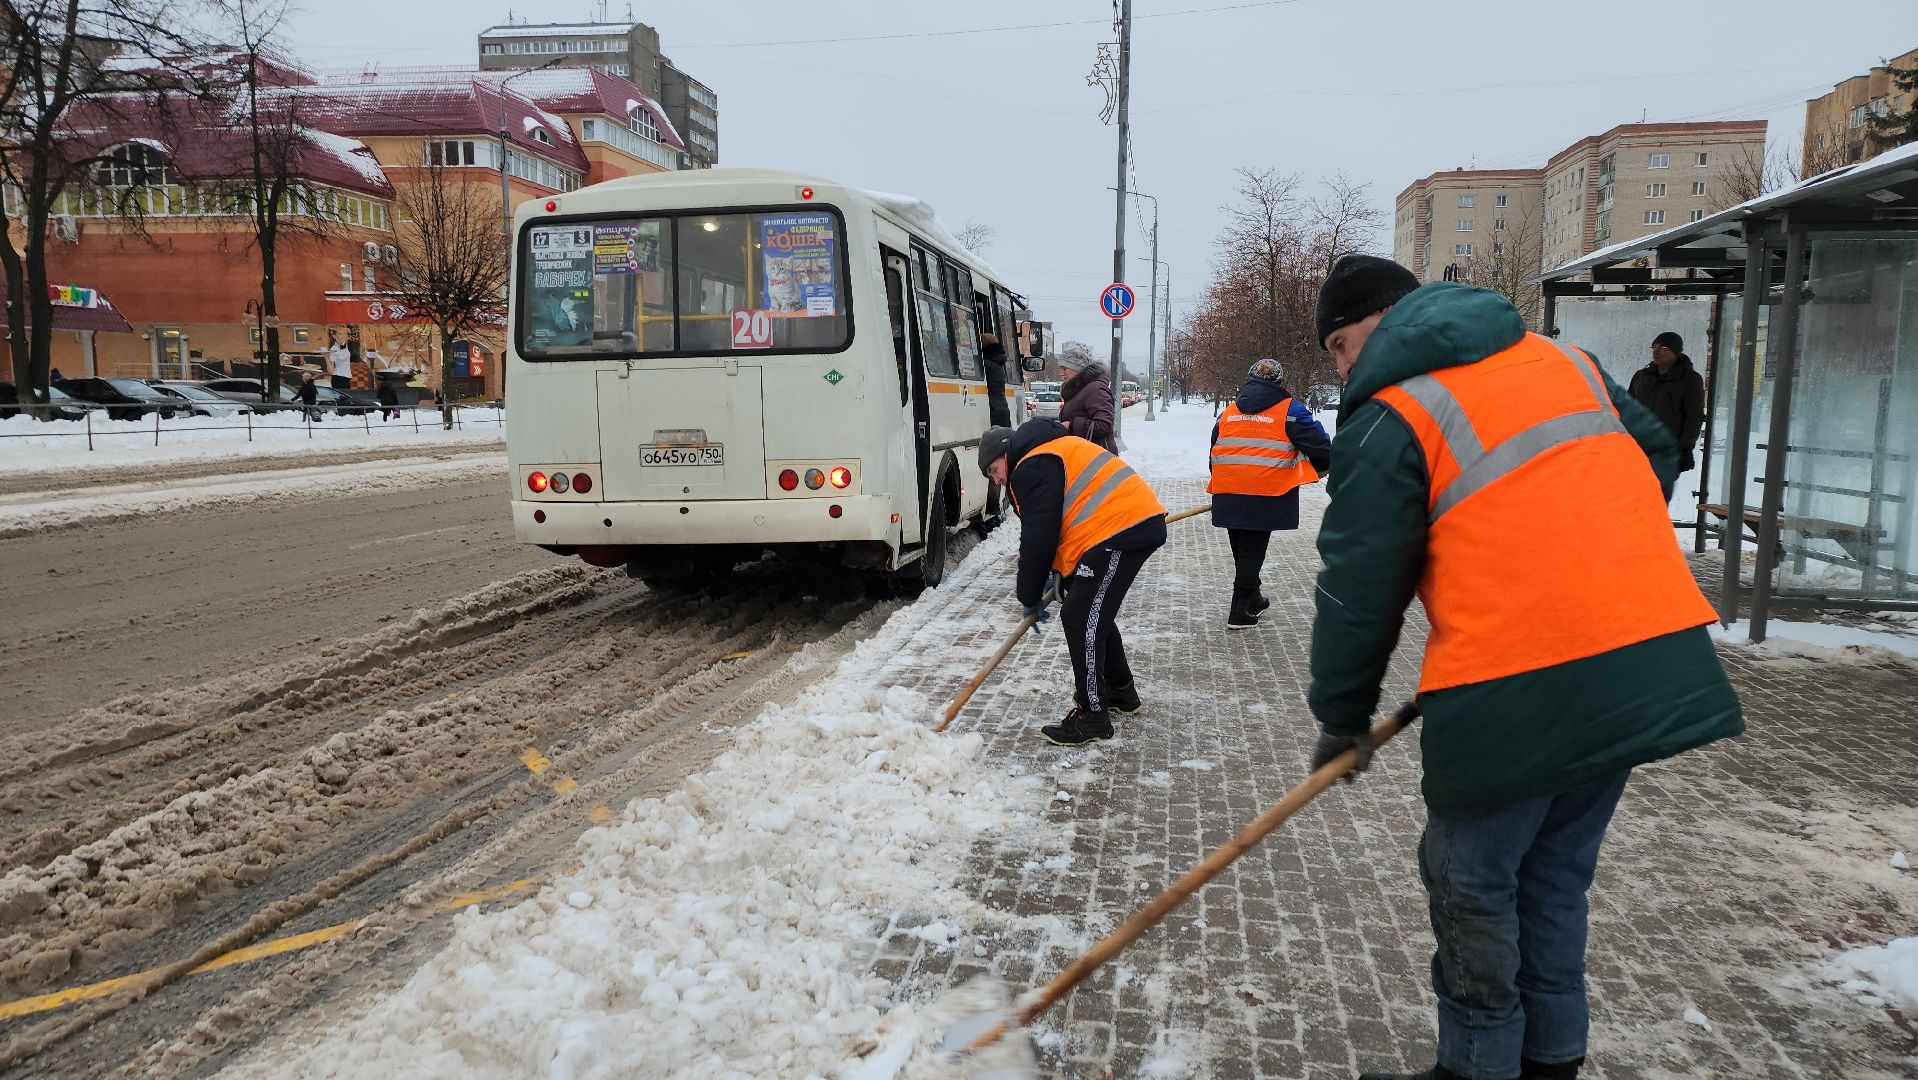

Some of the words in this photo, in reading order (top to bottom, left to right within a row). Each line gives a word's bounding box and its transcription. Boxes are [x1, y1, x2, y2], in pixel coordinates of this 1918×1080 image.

[535, 234, 546, 246] 17
[578, 233, 586, 244] 3
[767, 231, 826, 250] КОШЕК
[535, 251, 564, 260] ВЫСТАВКА
[535, 260, 573, 270] ТРОПИЧЕСКИХ
[535, 271, 586, 287] БАБОЧЕК
[735, 311, 769, 343] 20
[699, 449, 718, 458] 750
